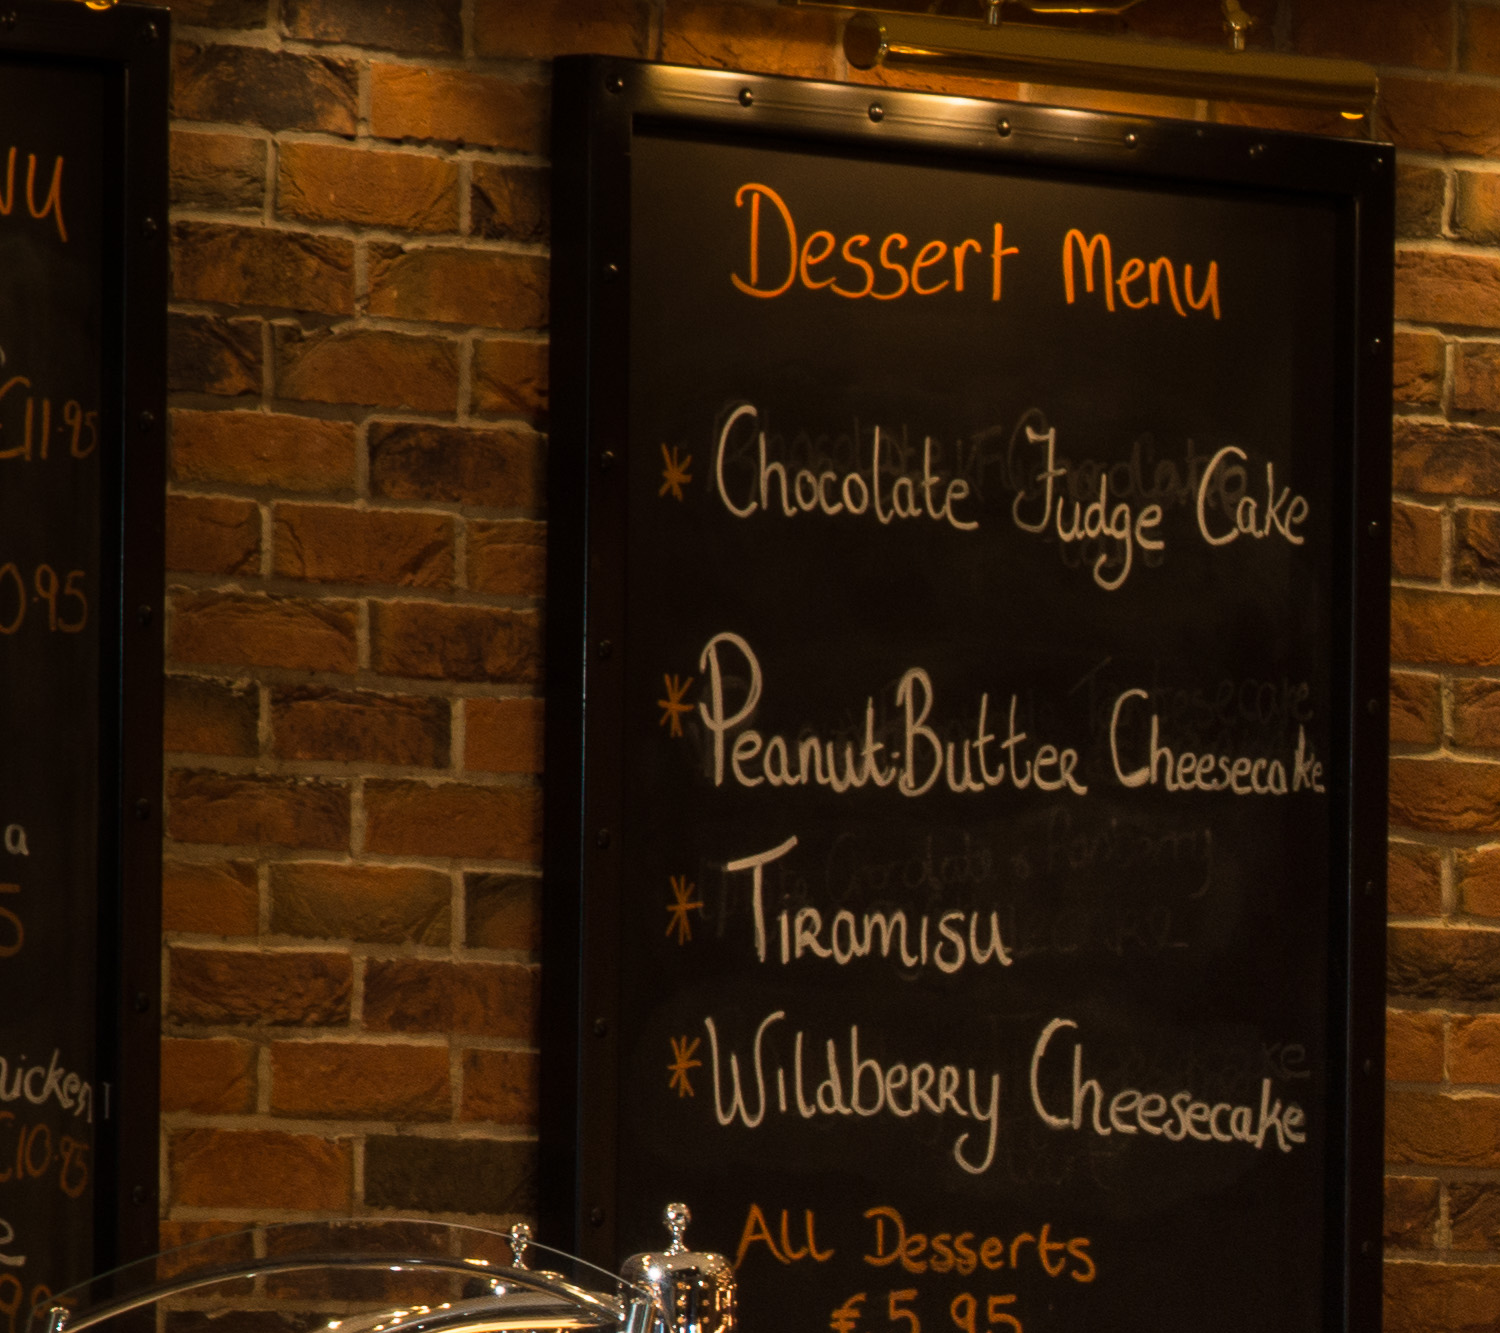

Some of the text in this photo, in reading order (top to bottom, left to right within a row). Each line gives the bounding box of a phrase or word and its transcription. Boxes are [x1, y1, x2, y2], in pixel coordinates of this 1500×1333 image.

[731, 183, 1222, 319] Dessert Menu
[716, 404, 1309, 590] Chocolate Fudge Cake
[1109, 688, 1326, 795] Cheesecake
[1029, 1017, 1306, 1152] Cheesecake
[863, 1205, 1096, 1283] Desserts
